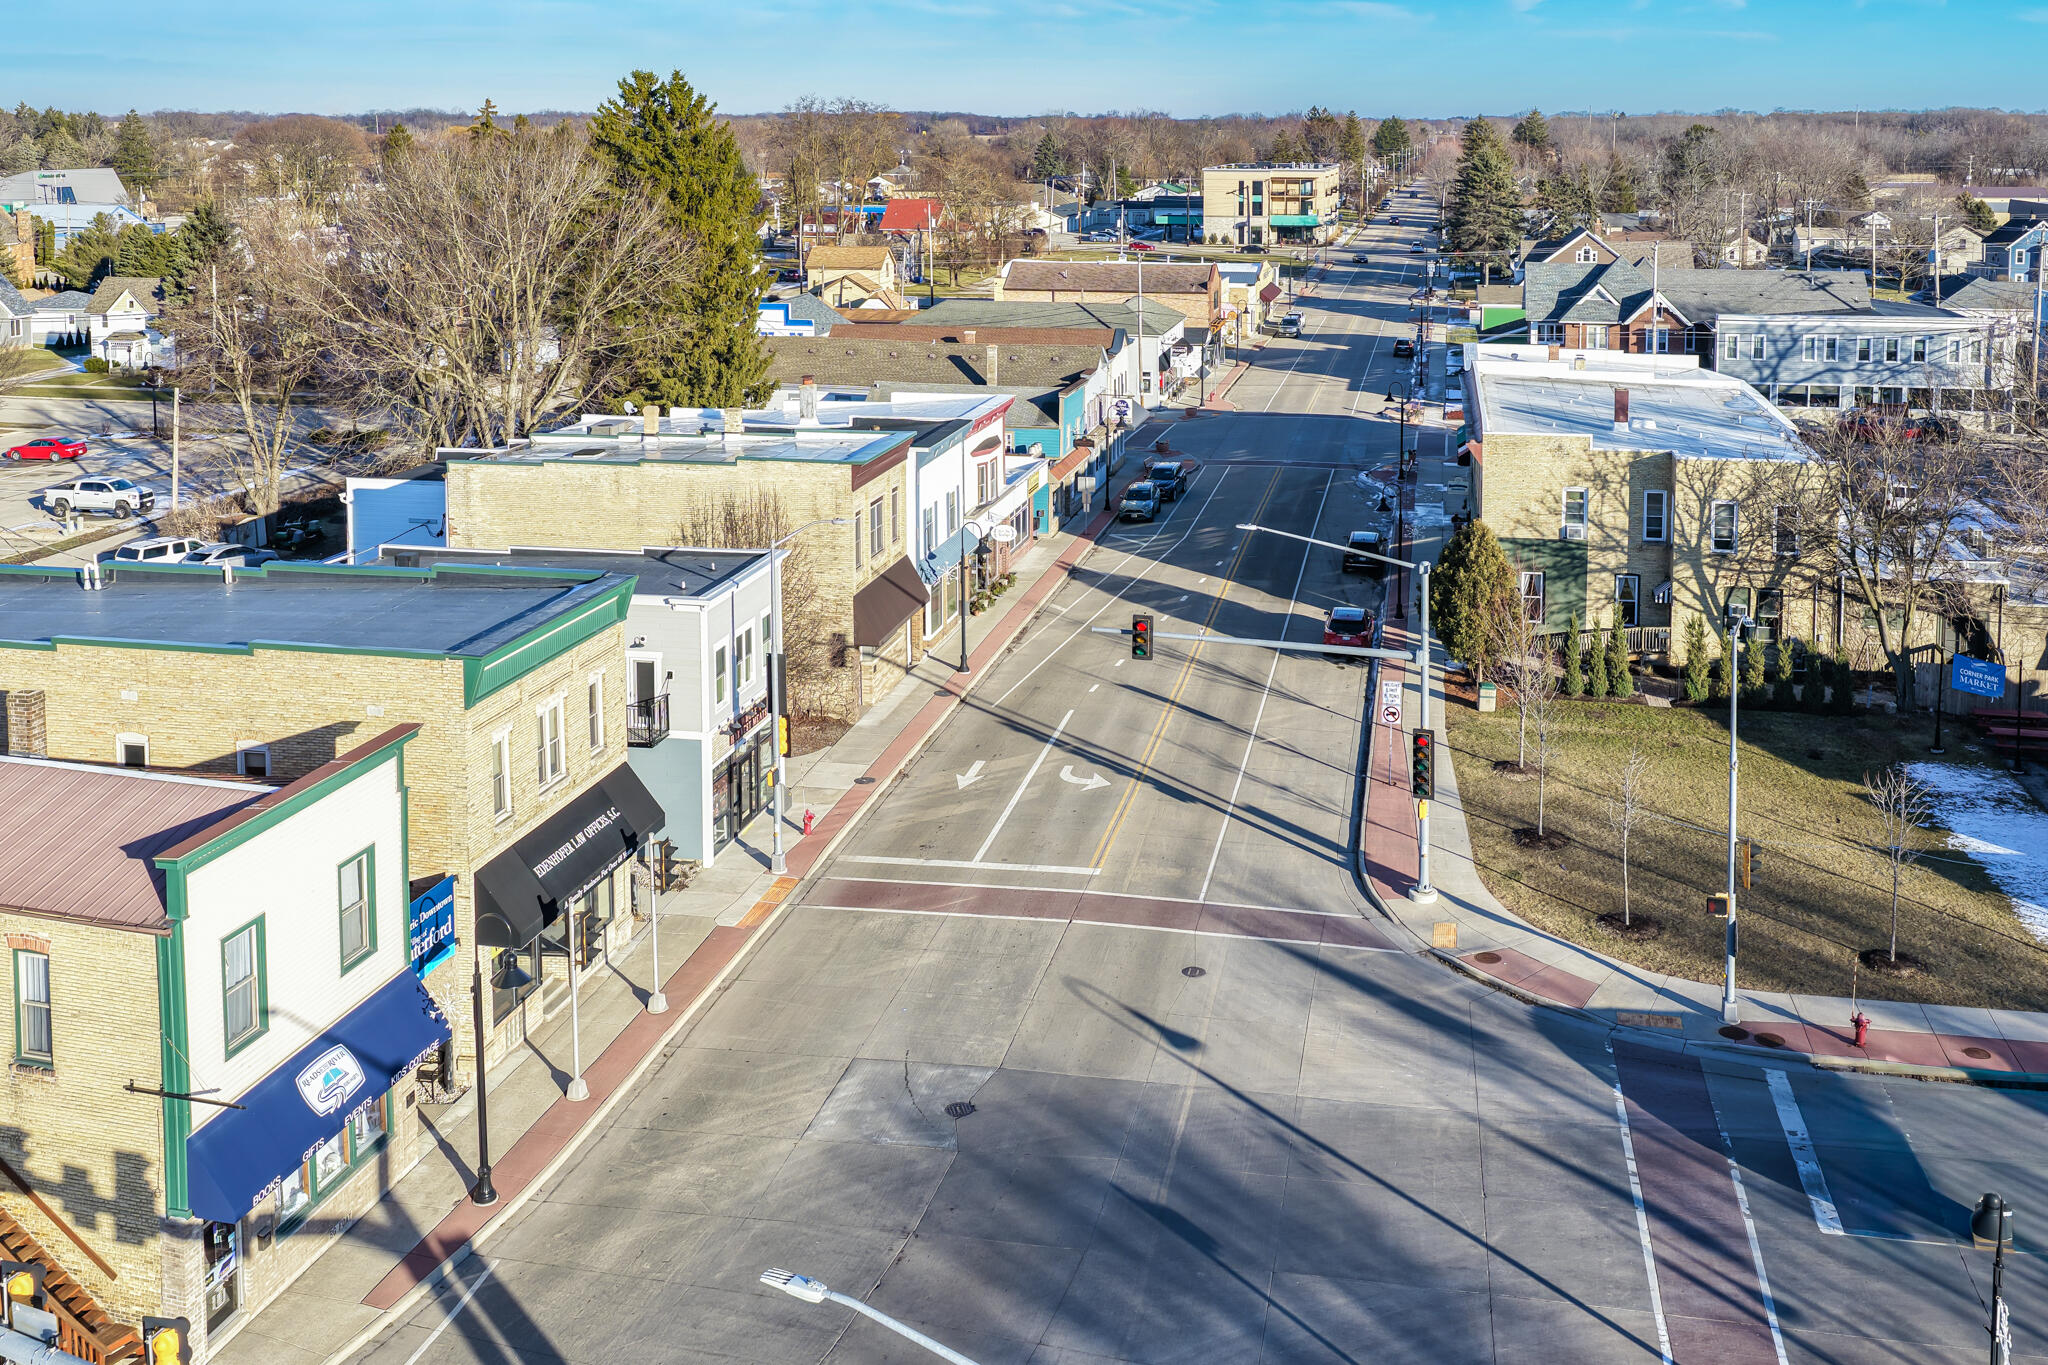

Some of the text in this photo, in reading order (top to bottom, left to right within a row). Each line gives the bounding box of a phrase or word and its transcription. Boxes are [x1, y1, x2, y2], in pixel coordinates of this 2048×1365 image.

[1960, 668, 1999, 683] CORNER PARK
[1960, 674, 1999, 691] MARKET
[532, 842, 576, 879] EDENHOFER
[570, 831, 587, 849] LAW
[583, 814, 613, 839] OFFICES,
[420, 894, 453, 923] Downtown
[411, 913, 453, 962] terford
[302, 1068, 321, 1088] READS
[328, 1050, 346, 1067] RIVER
[390, 1063, 409, 1086] KIDS'
[408, 1038, 440, 1070] COTTAGE
[344, 1095, 373, 1127] EVENTS
[302, 1137, 325, 1163] GIFTS
[252, 1175, 281, 1207] BOOKS
